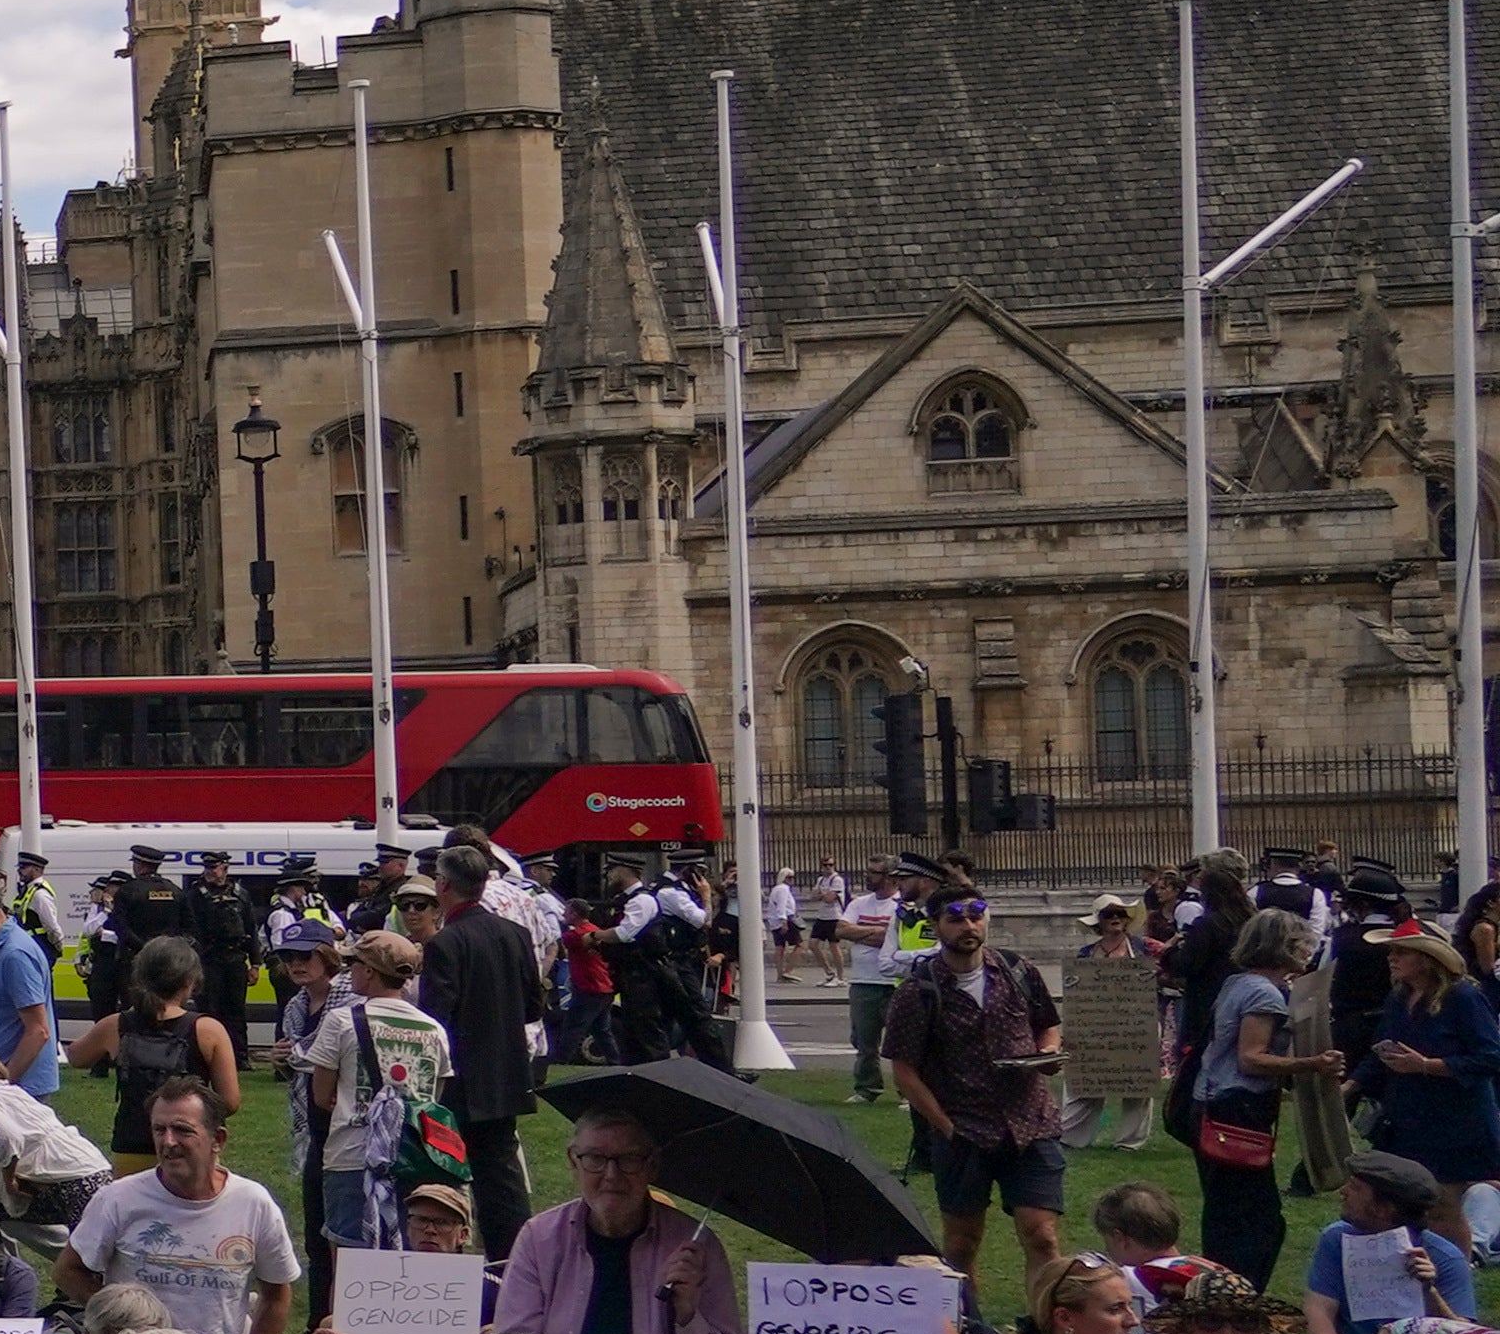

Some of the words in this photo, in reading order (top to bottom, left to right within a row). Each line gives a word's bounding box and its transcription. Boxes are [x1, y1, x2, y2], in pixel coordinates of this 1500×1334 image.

[607, 795, 685, 810] Stagecoach
[136, 1269, 173, 1286] Gulf
[179, 1271, 201, 1286] Of
[343, 1279, 463, 1301] OPPOSE
[783, 1276, 919, 1309] OPPOSE
[346, 1307, 468, 1327] GENOCIDE
